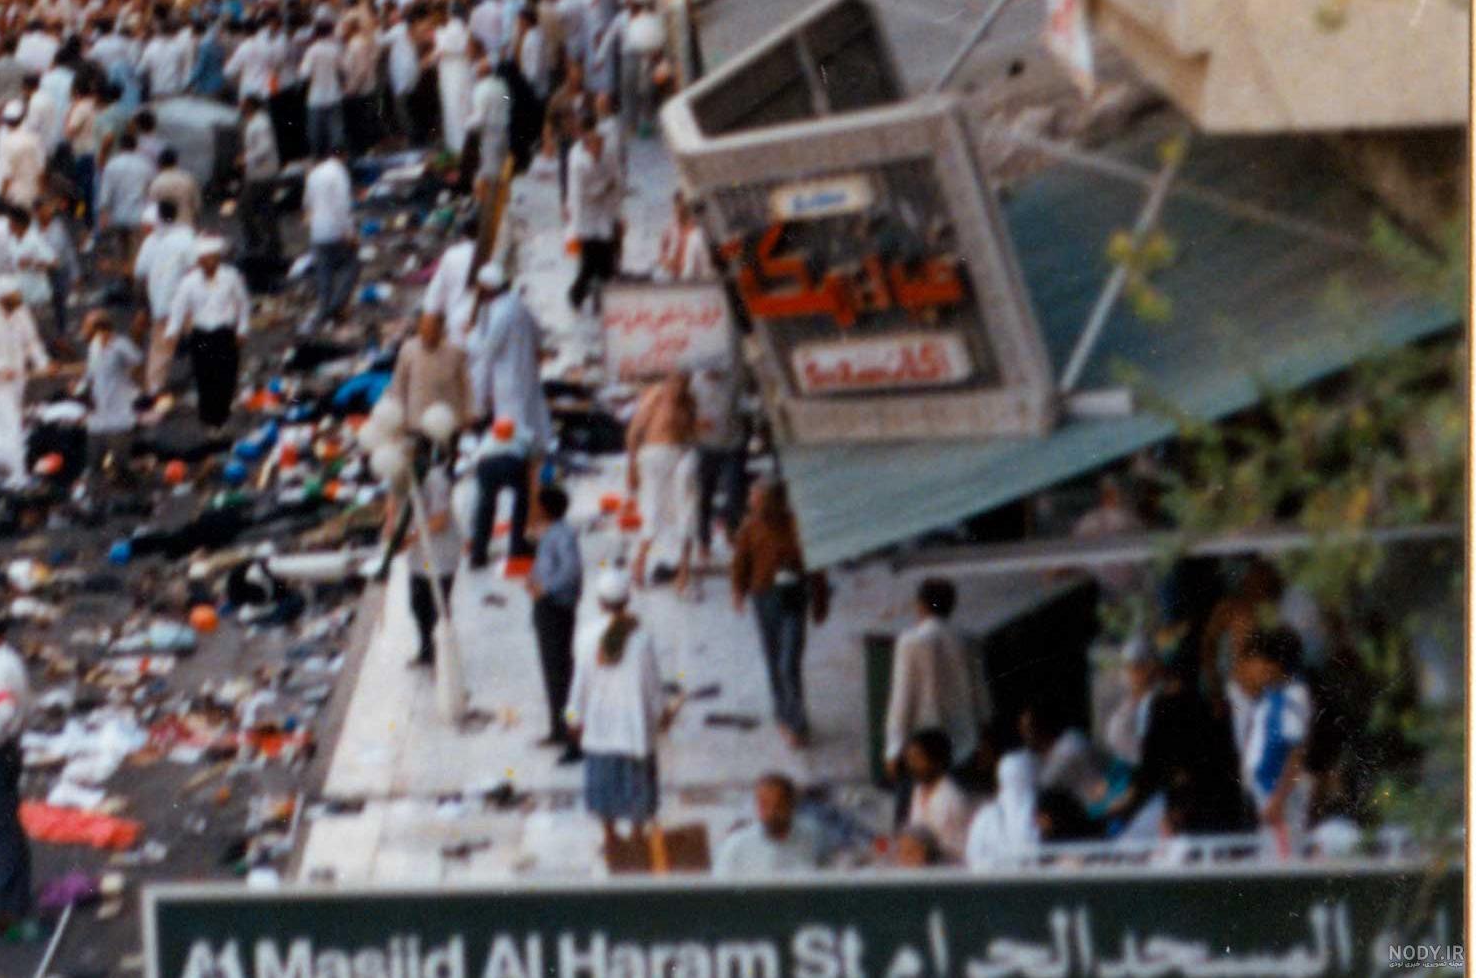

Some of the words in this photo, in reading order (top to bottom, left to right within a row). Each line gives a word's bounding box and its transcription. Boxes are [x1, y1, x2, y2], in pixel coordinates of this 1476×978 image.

[252, 932, 465, 978] Masjid
[484, 931, 542, 978] Al
[557, 930, 781, 978] Haram
[792, 924, 864, 978] St
